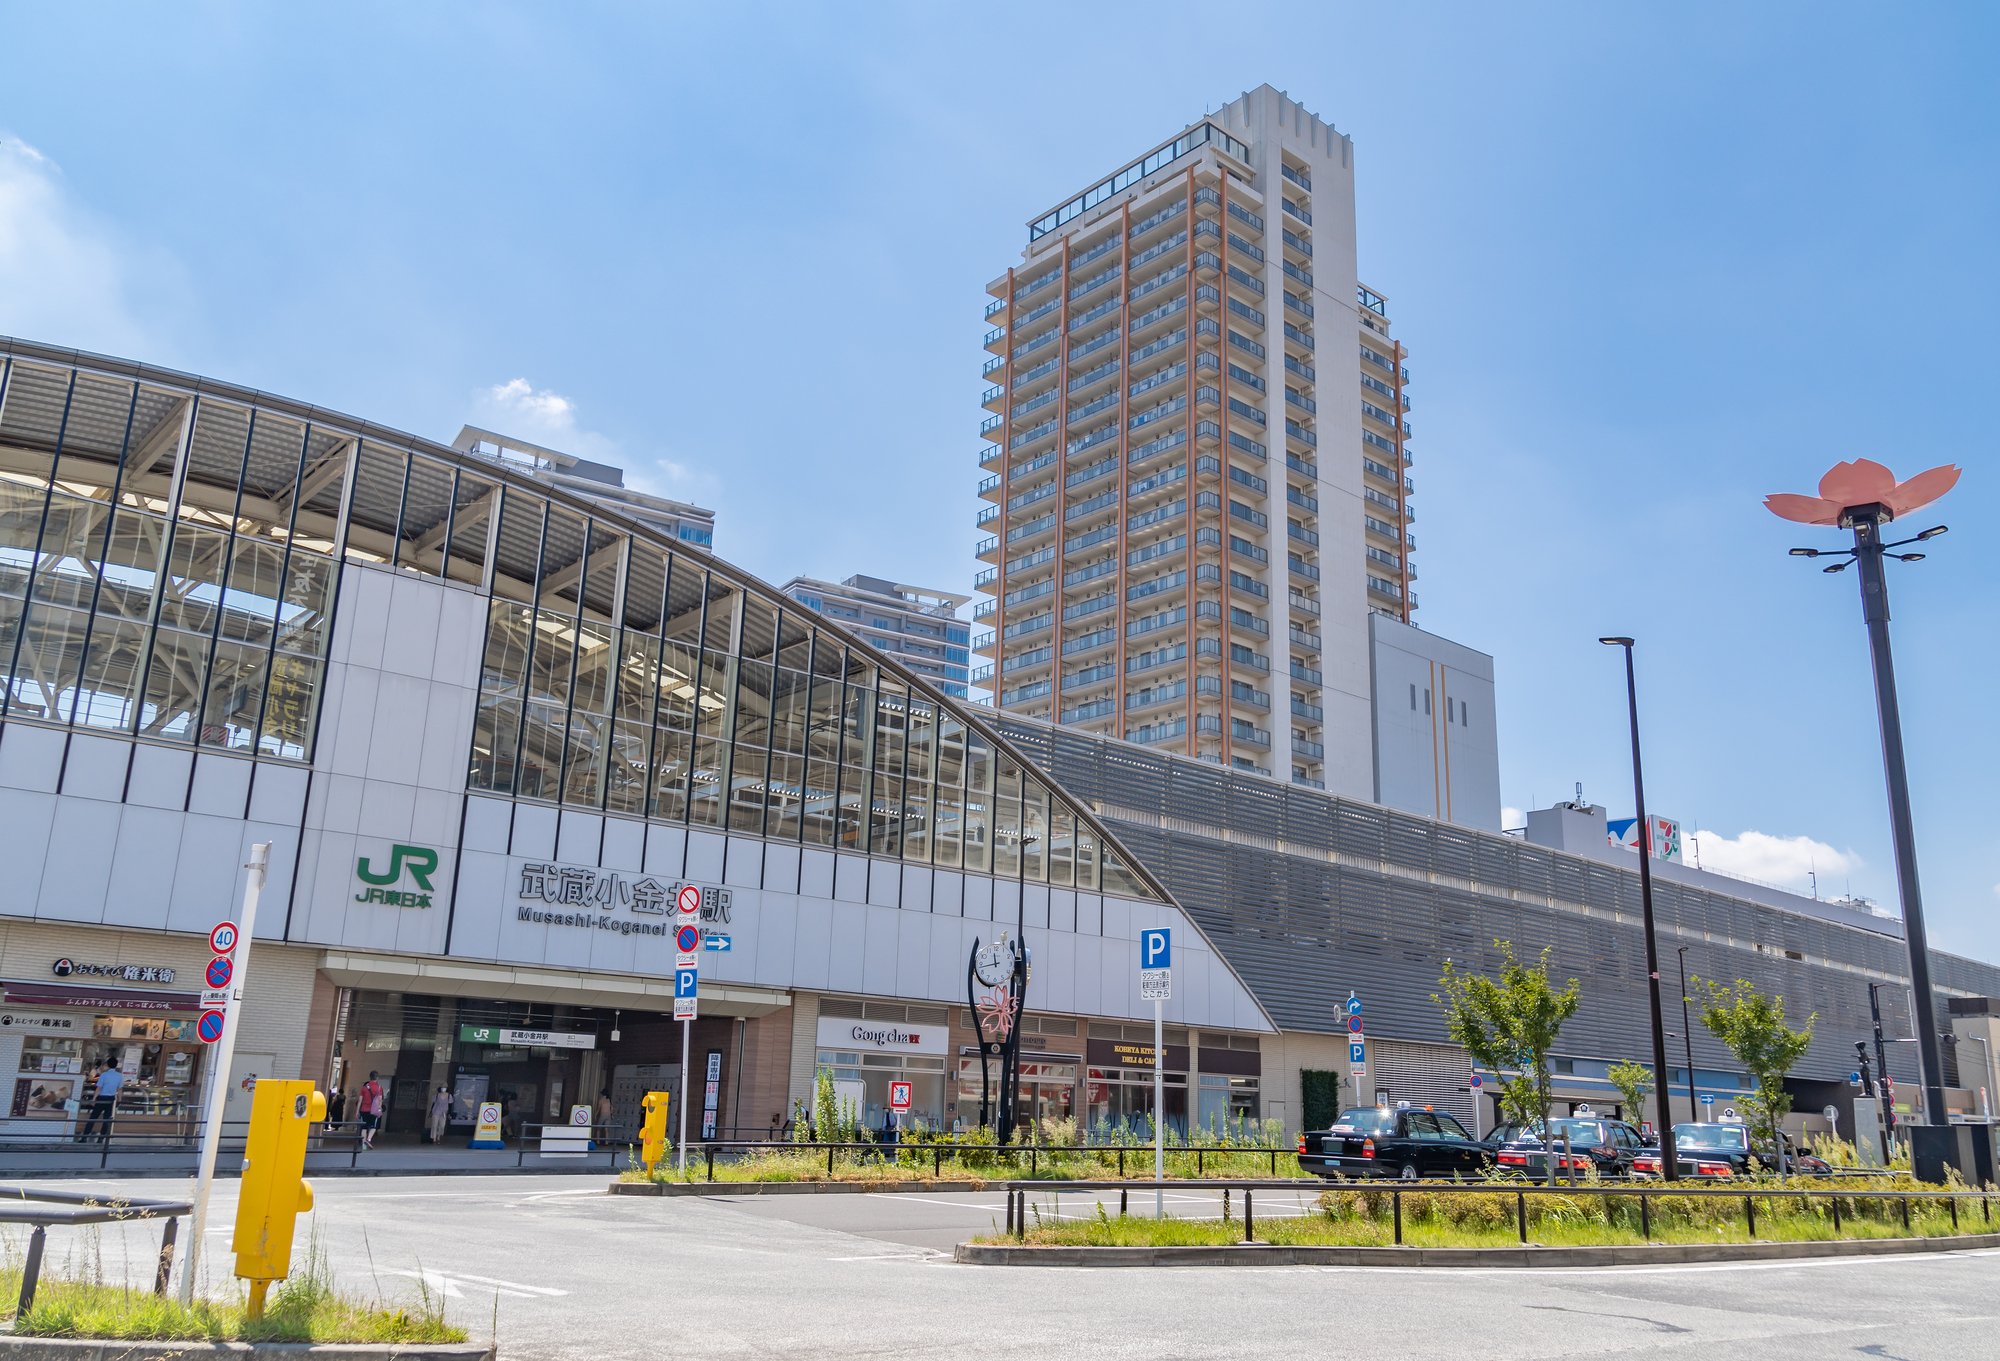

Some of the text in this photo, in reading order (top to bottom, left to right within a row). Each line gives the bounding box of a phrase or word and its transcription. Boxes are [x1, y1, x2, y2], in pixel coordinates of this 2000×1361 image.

[357, 844, 438, 892] JR
[355, 887, 433, 909] JR東日本
[517, 906, 667, 936] Musashi-Koganei
[216, 931, 233, 946] 40
[1149, 933, 1165, 964] P
[681, 972, 694, 995] P
[1142, 990, 1169, 998] ここから
[474, 1029, 490, 1038] JR
[510, 1032, 549, 1040] 武蔵小金井駅
[852, 1026, 886, 1046] Gong
[887, 1029, 908, 1044] cha
[1114, 1045, 1168, 1056] KOBEYA KITCN
[1354, 1046, 1362, 1060] P
